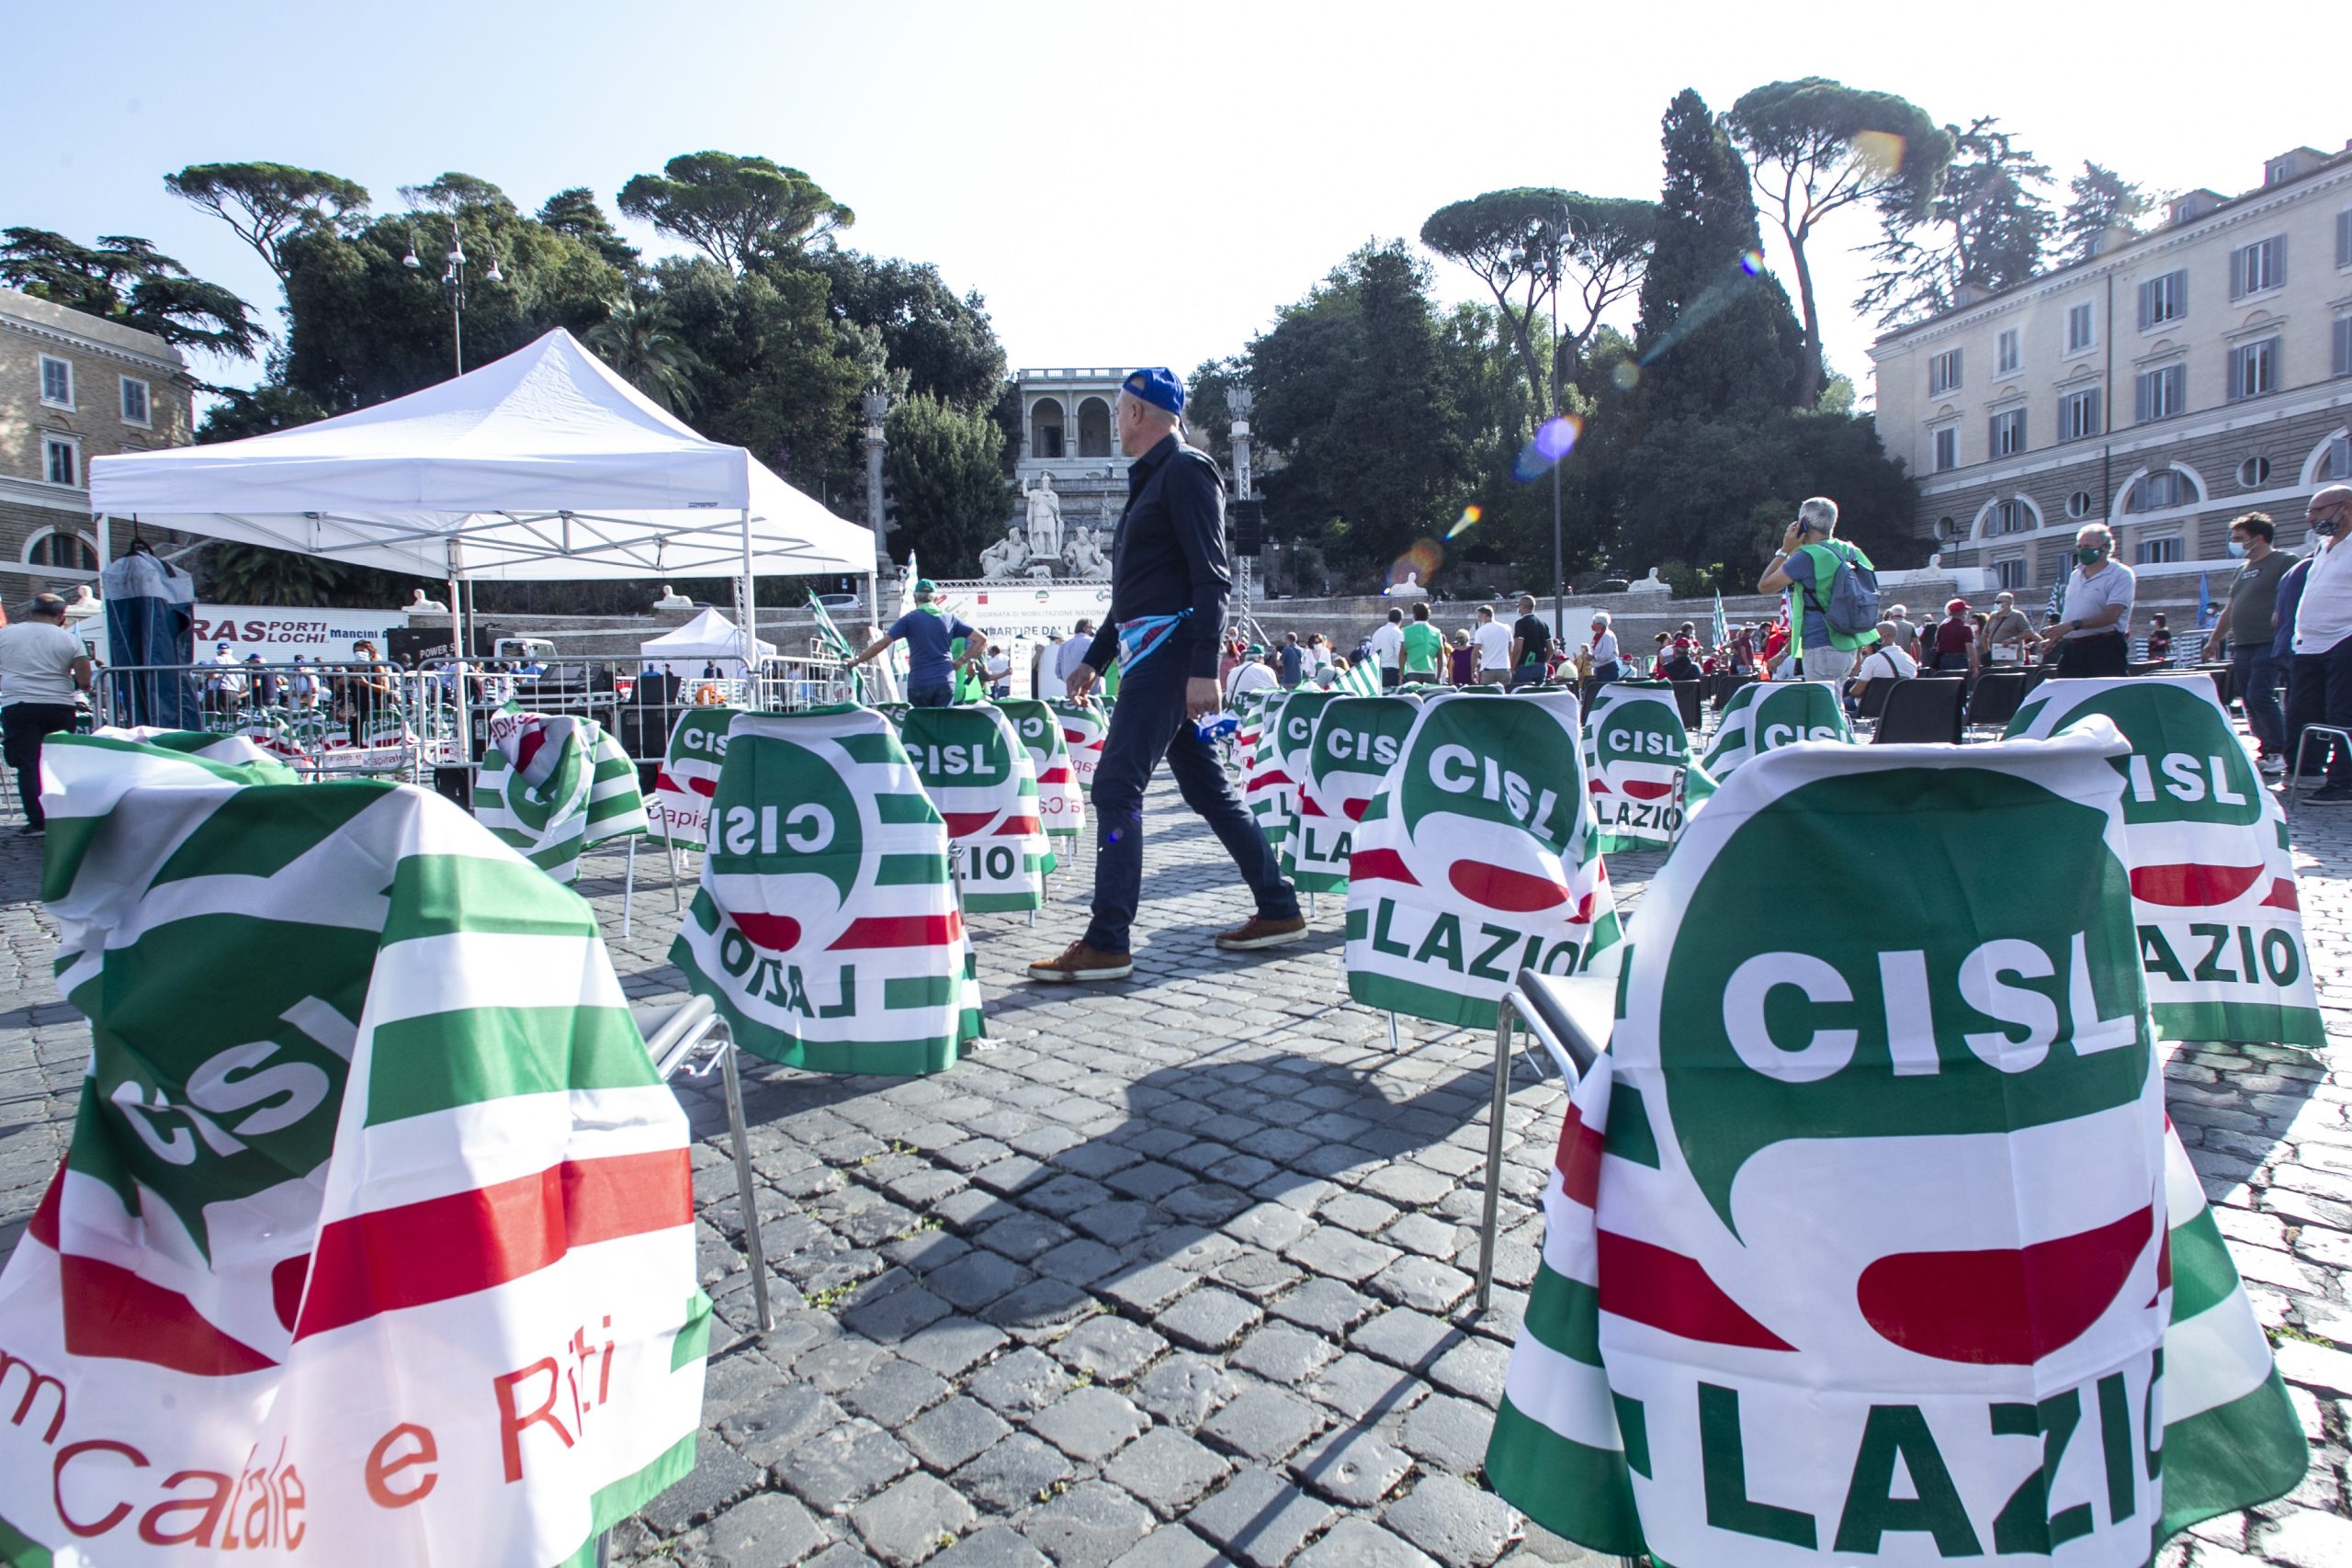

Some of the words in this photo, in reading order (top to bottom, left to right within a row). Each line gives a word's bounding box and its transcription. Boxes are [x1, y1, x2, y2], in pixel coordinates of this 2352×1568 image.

[193, 620, 266, 642] RAS
[267, 633, 325, 643] LOCHI
[269, 622, 327, 632] PORTI
[331, 629, 378, 638] Mancini
[420, 644, 447, 659] POWER
[684, 728, 727, 754] CIS
[1327, 728, 1397, 765] CIS
[1609, 728, 1681, 758] CISL
[1429, 743, 1557, 841] CISL
[2129, 752, 2247, 806] ISL
[1597, 801, 1683, 832] LAZIO
[1373, 897, 1579, 986] LAZIO
[2136, 923, 2300, 987] AZIO
[1723, 931, 2136, 1083] CISL
[365, 1422, 438, 1508] e
[1697, 1347, 2164, 1558] LAZI
